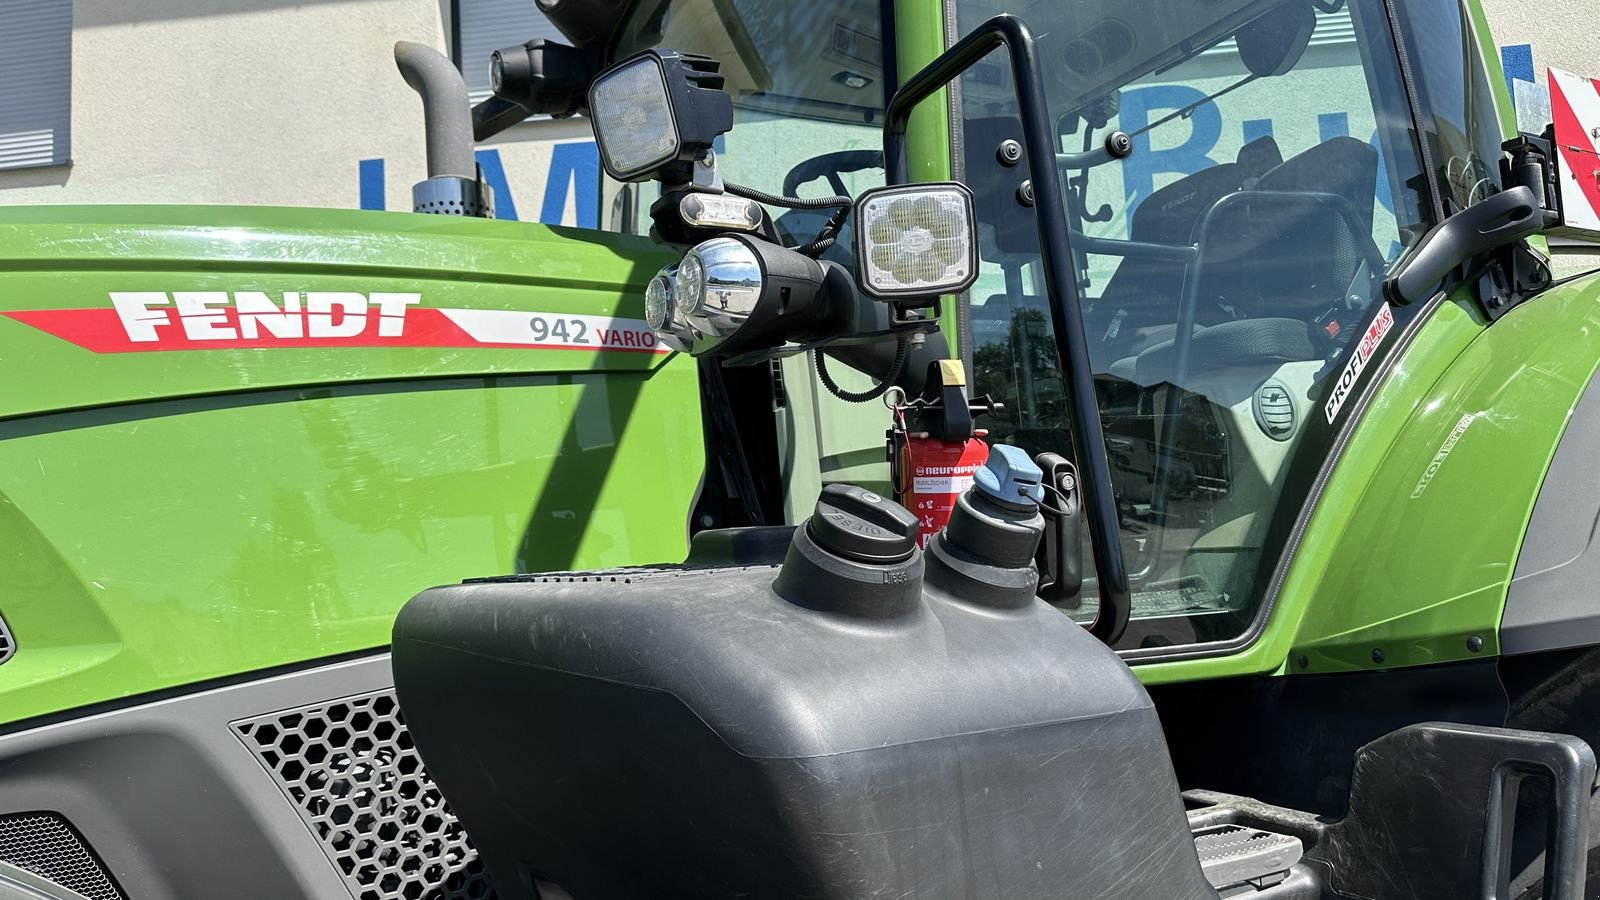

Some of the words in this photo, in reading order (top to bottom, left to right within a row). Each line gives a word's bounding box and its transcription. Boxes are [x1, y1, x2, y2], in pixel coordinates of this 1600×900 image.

[108, 291, 422, 343] FENDT
[529, 316, 590, 344] 942
[596, 328, 656, 348] VARIO
